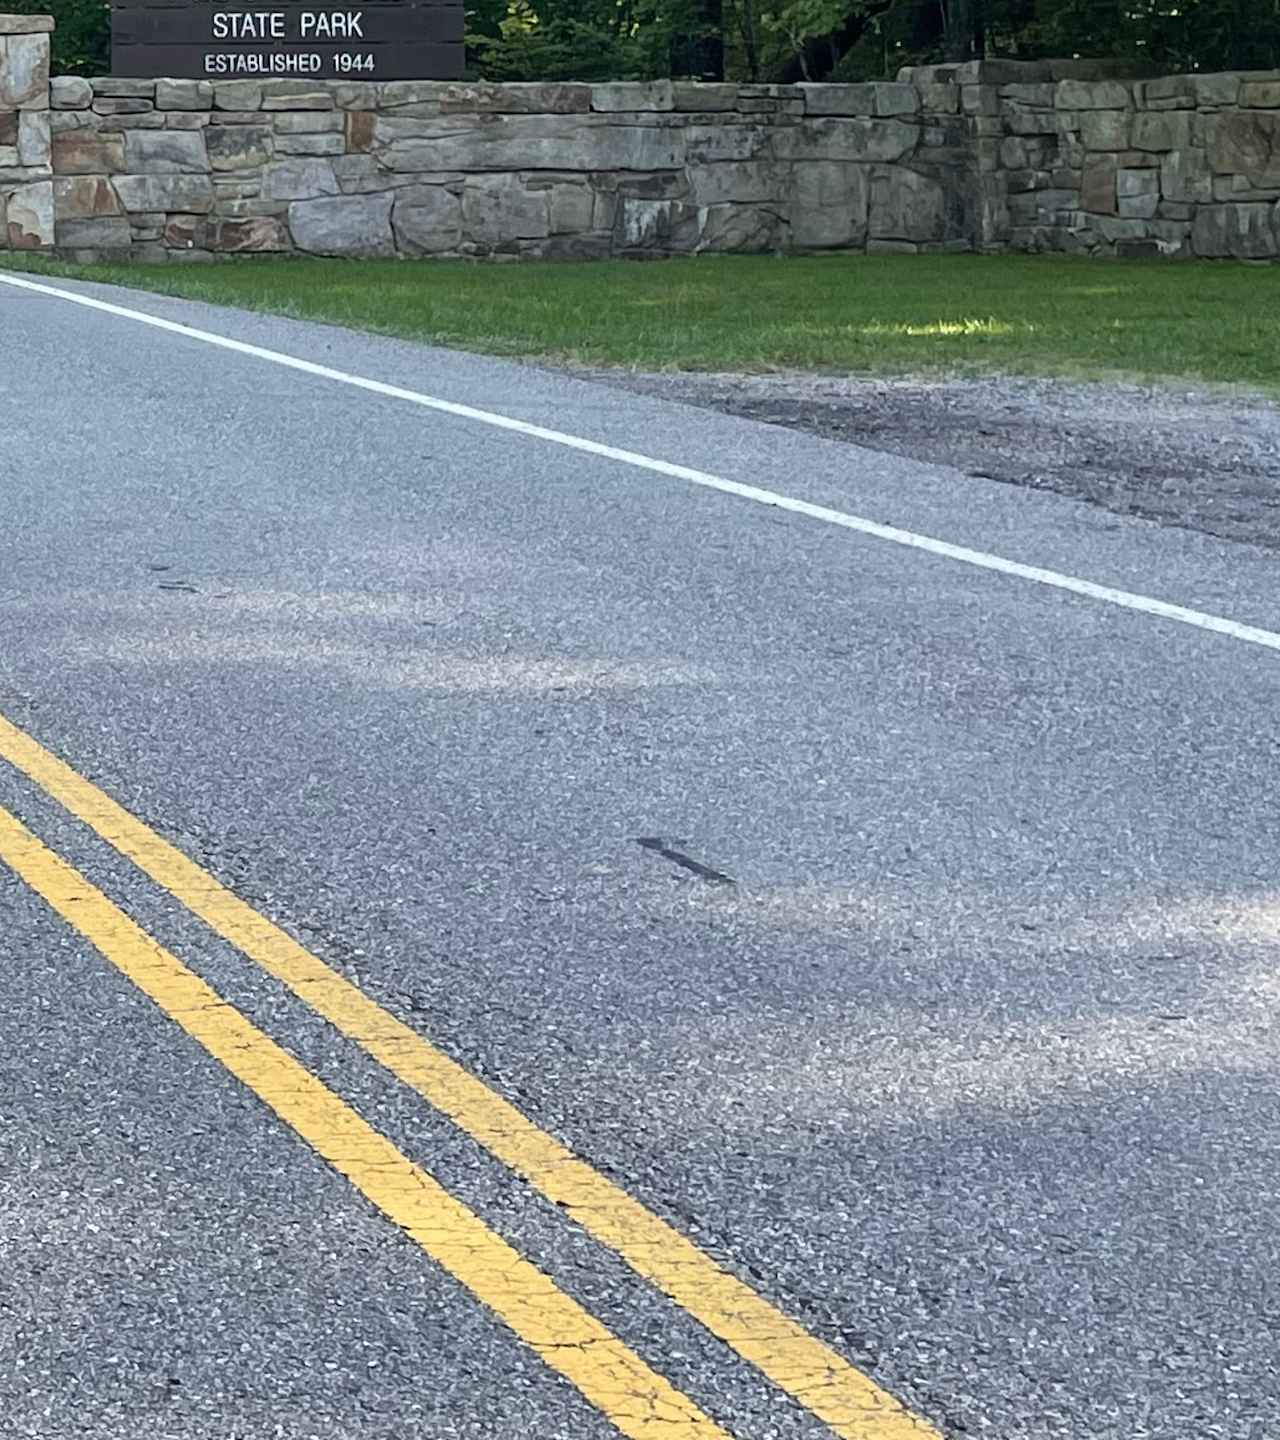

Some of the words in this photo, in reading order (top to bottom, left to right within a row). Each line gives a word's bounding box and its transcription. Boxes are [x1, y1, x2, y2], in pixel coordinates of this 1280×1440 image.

[213, 13, 285, 37] STATE
[301, 12, 363, 37] PARK
[205, 54, 321, 72] ESTABLISHED
[333, 54, 374, 72] 1944
